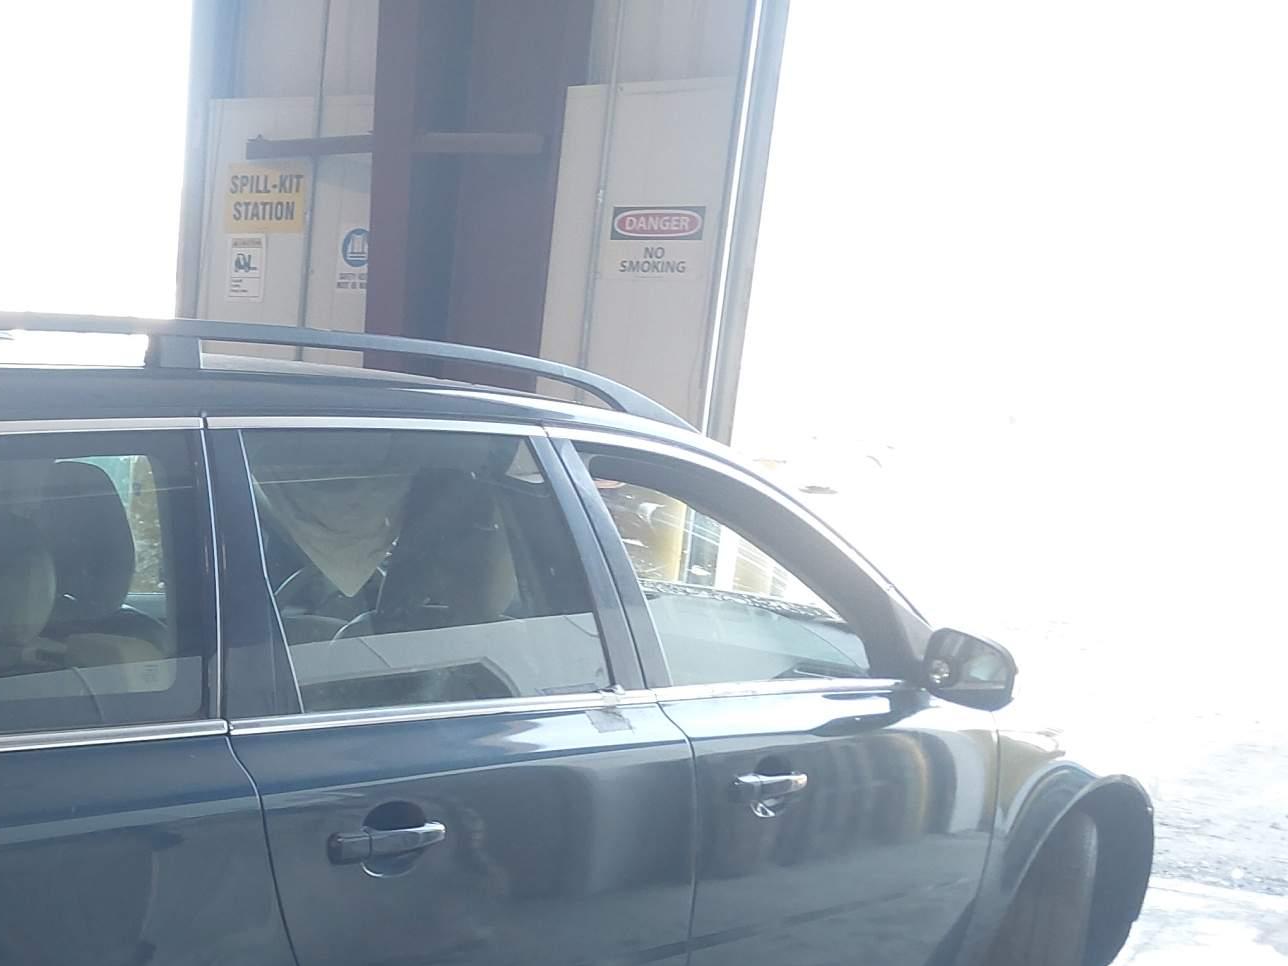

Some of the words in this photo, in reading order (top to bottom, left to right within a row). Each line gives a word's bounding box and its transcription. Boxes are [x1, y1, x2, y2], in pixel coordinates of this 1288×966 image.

[230, 174, 304, 194] SPILL-KIT
[233, 202, 295, 221] STATION
[624, 216, 691, 231] DANGER
[643, 246, 665, 259] NO
[618, 260, 687, 273] SMOKING
